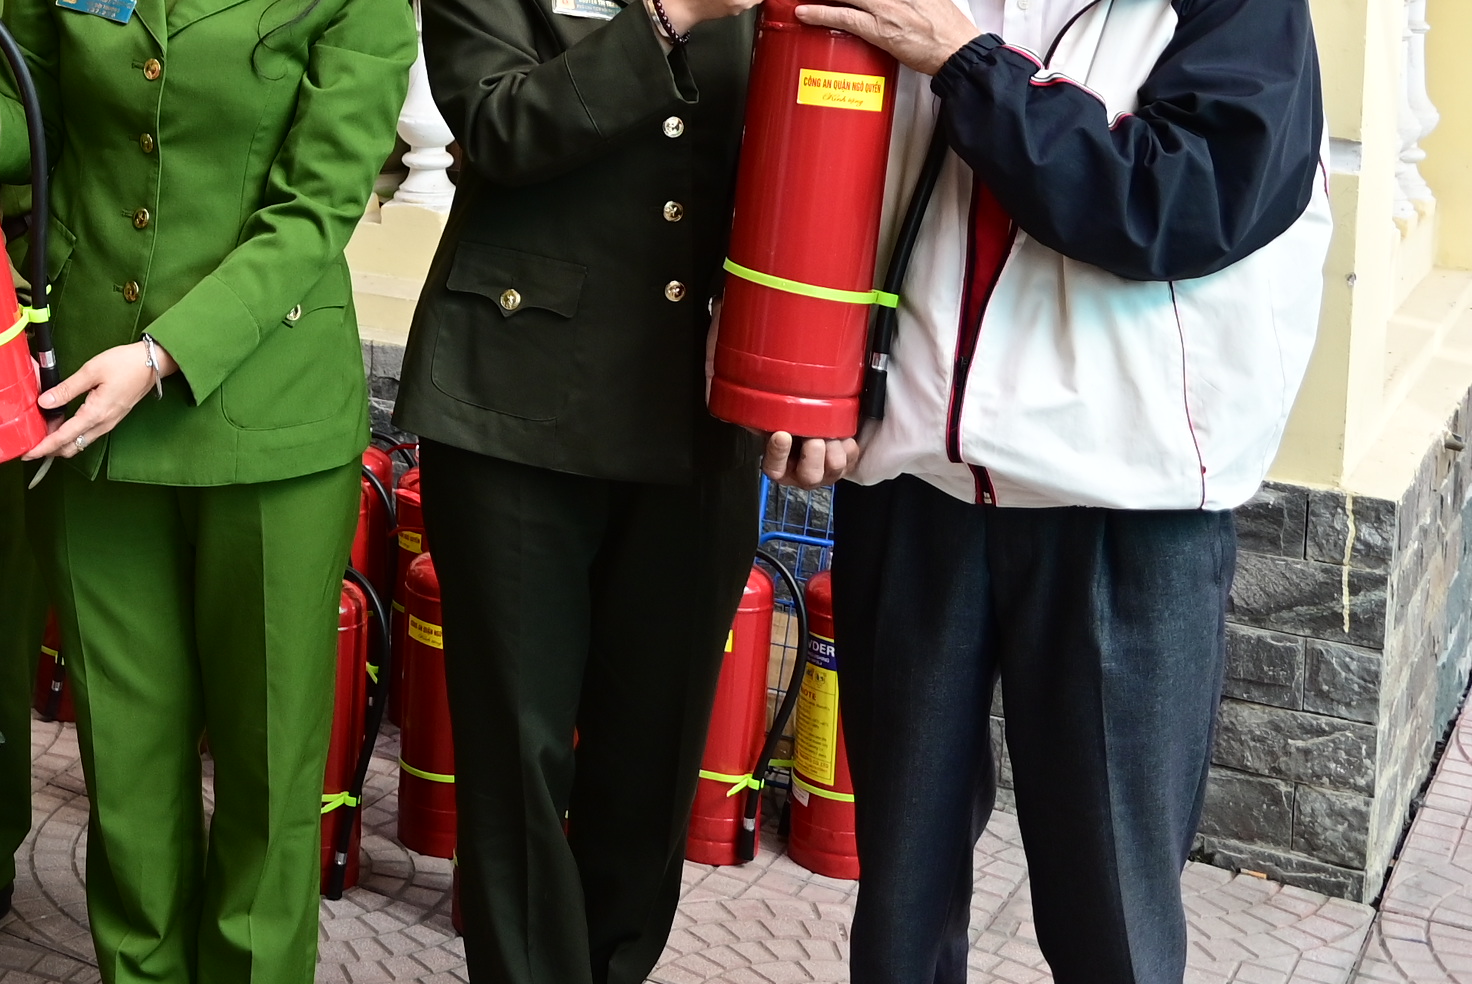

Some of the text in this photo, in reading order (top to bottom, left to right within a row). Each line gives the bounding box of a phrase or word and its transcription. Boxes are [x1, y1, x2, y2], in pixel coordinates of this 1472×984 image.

[803, 75, 821, 87] CÔNG
[822, 79, 832, 88] AN
[833, 79, 850, 92] QUẬN
